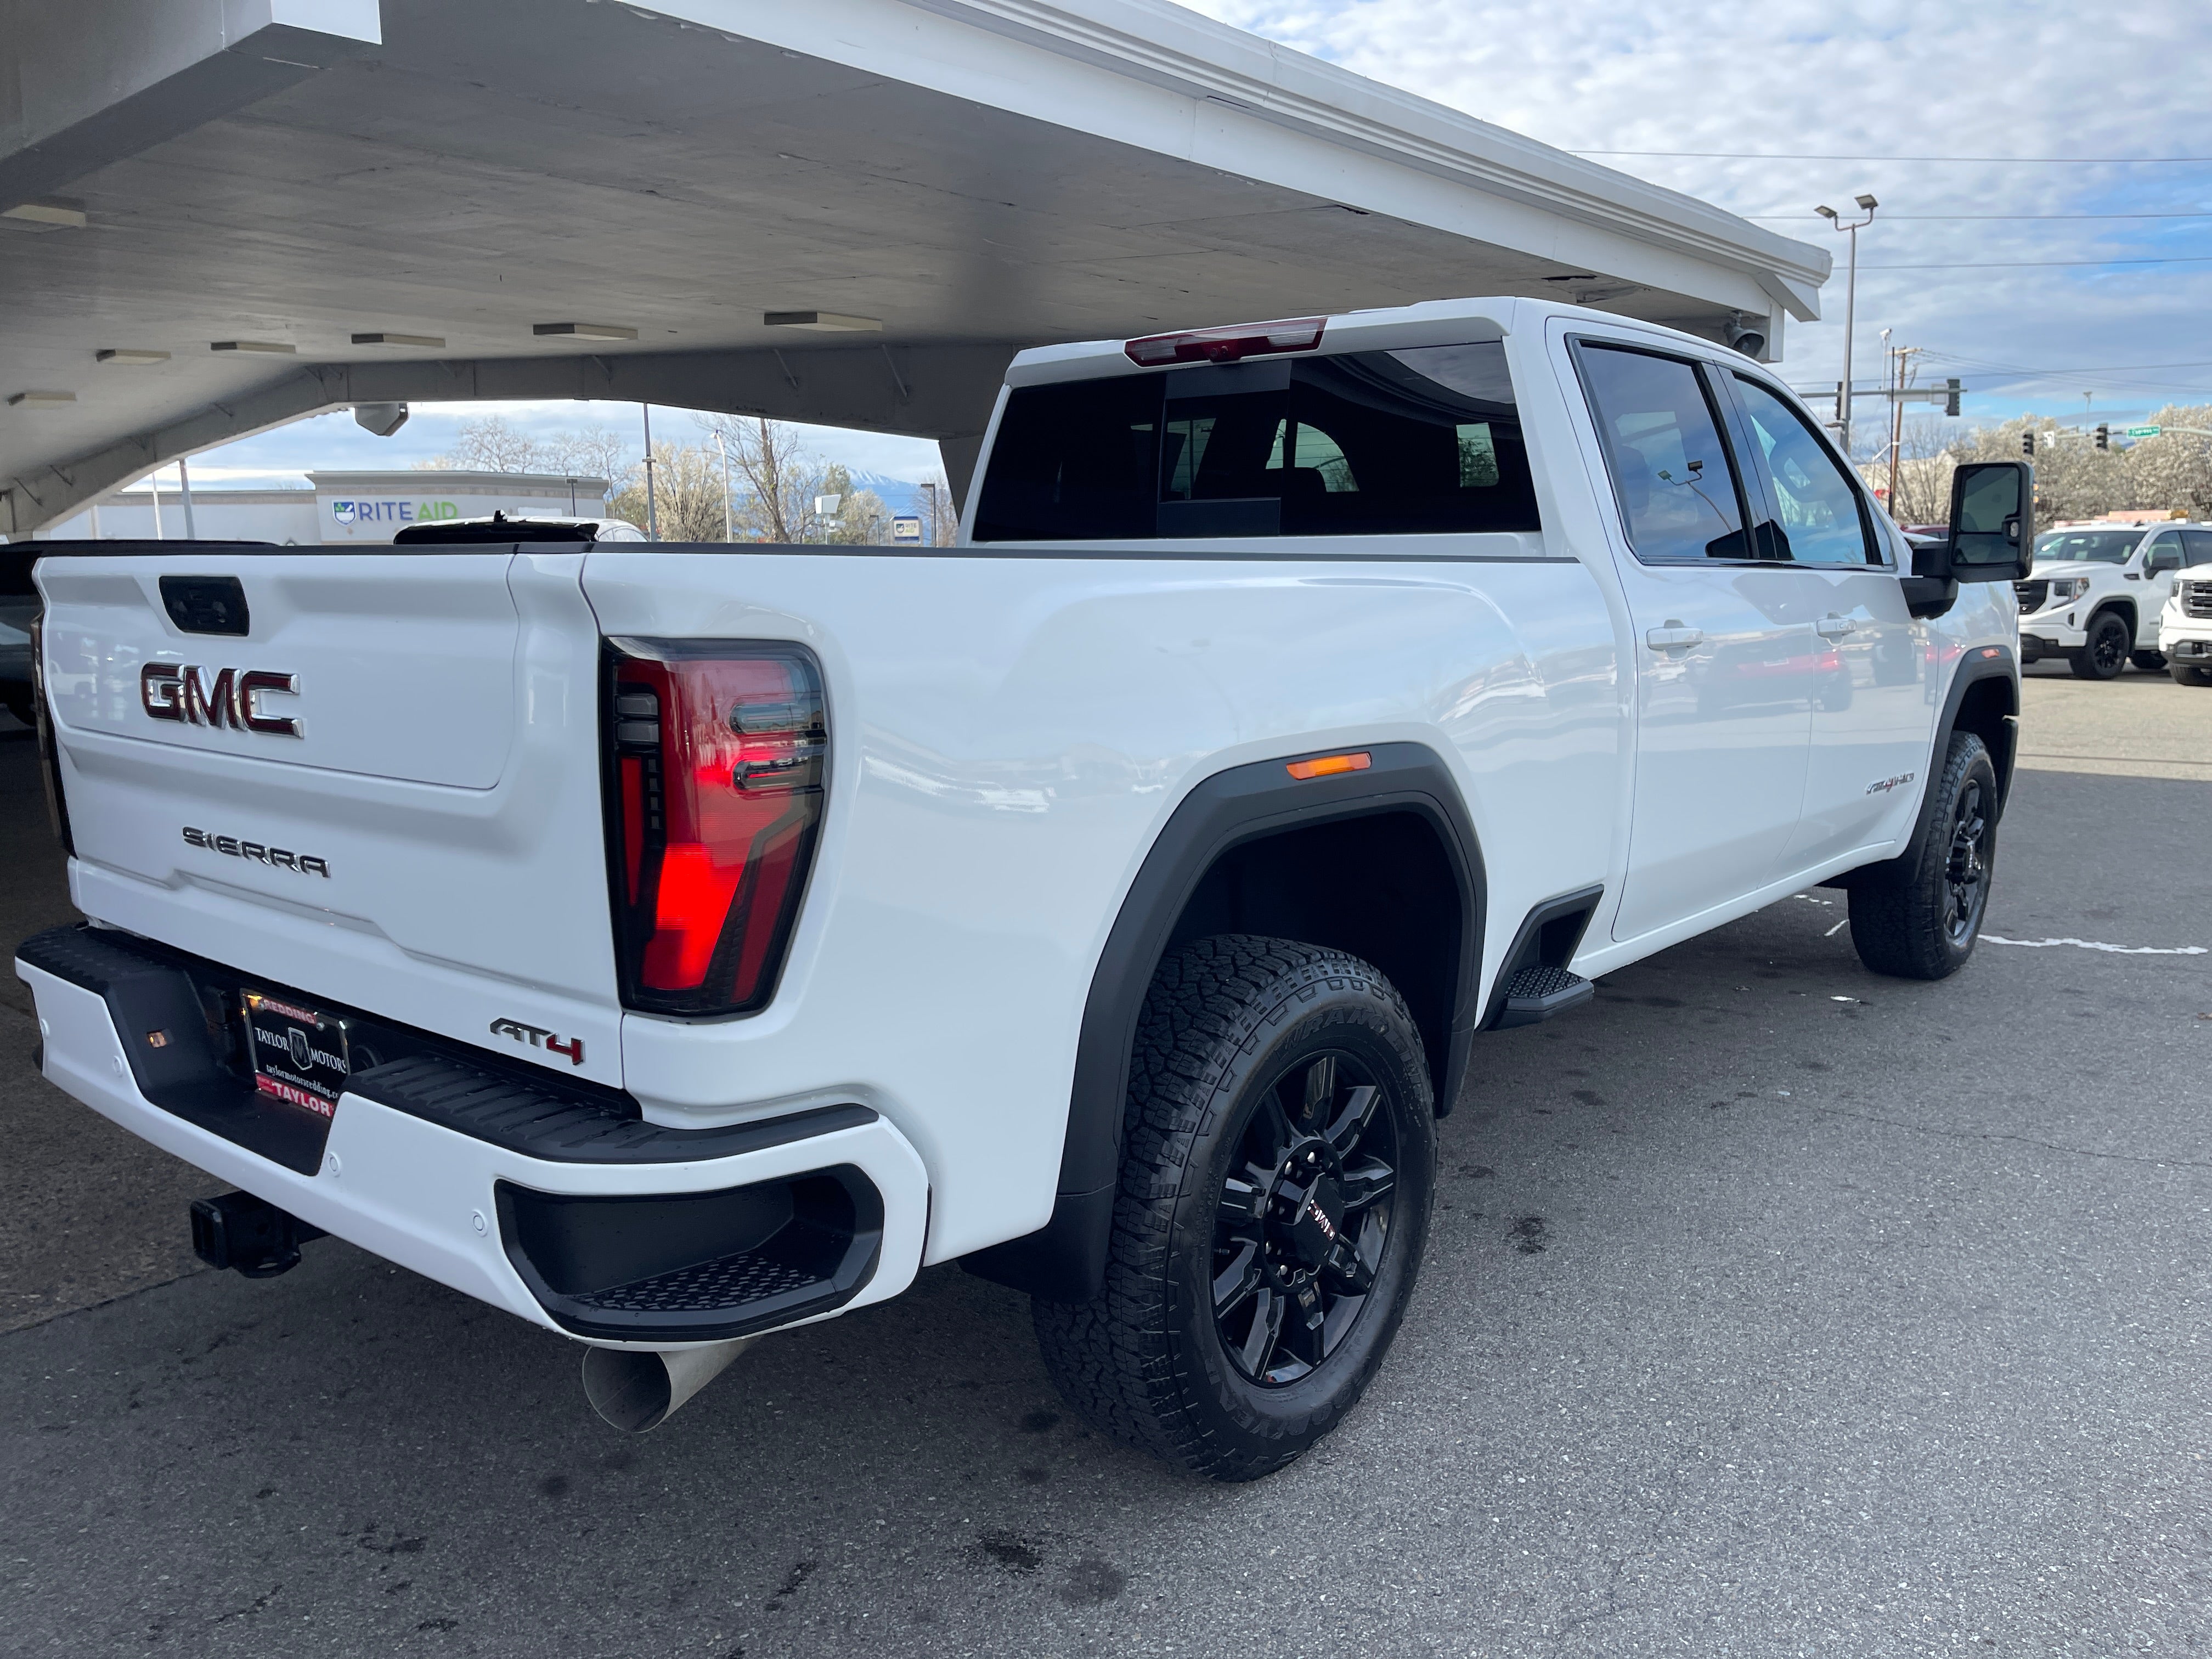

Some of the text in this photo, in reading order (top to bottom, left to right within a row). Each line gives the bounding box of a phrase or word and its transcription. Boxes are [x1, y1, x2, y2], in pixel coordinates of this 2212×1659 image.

[359, 501, 458, 522] RITE AID
[140, 662, 305, 740] GMC
[182, 826, 331, 879] SIERRA
[264, 999, 316, 1025] REDDING
[255, 1027, 290, 1052] TAYLOR
[310, 1048, 347, 1074] MOTORS
[489, 1018, 586, 1066] AT4
